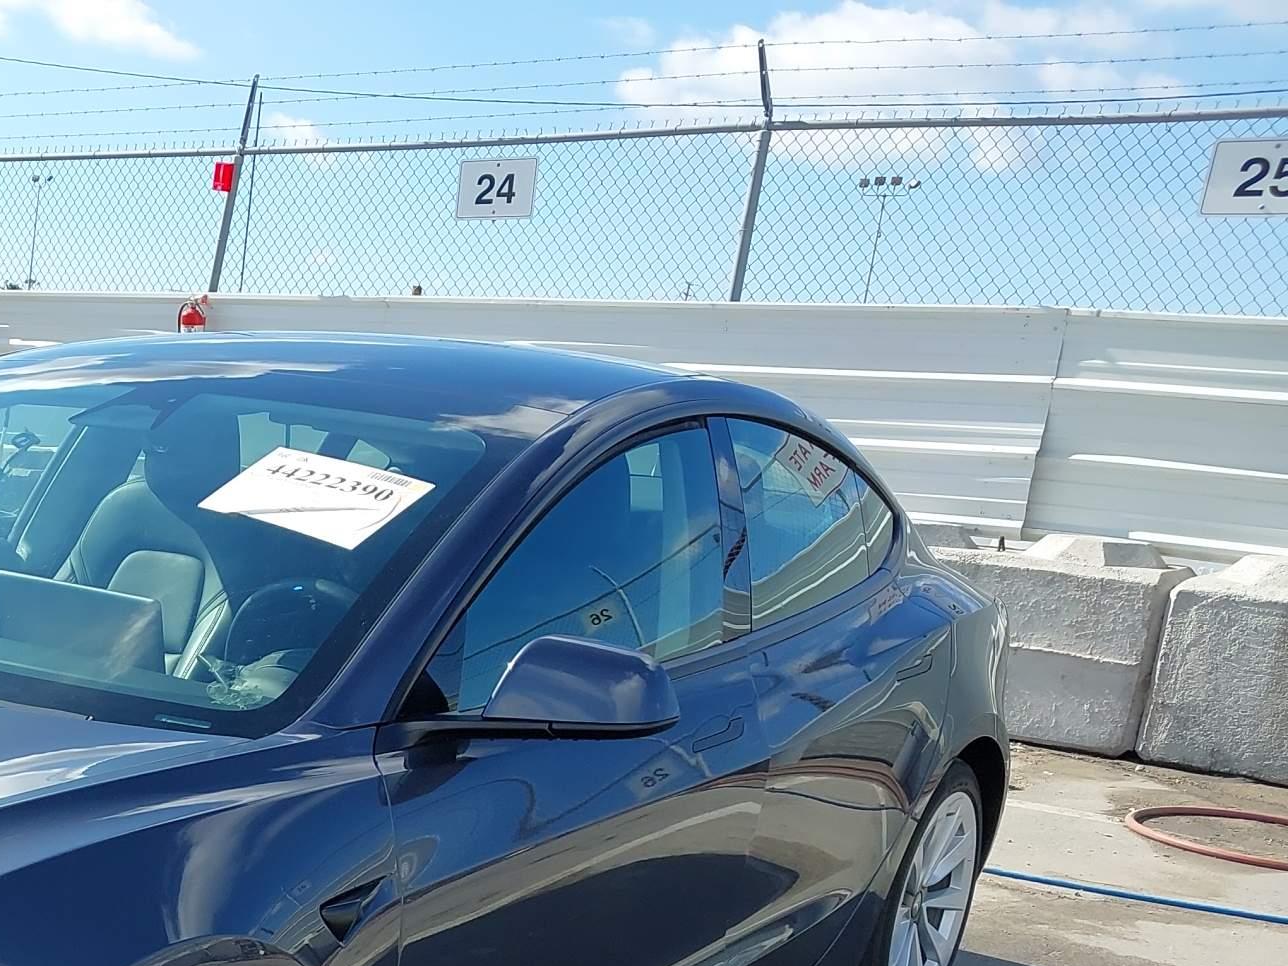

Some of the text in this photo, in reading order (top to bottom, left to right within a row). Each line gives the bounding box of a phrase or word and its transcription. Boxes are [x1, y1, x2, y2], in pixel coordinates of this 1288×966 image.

[475, 173, 516, 205] 24
[1233, 157, 1288, 197] 25
[266, 464, 394, 501] 44222390
